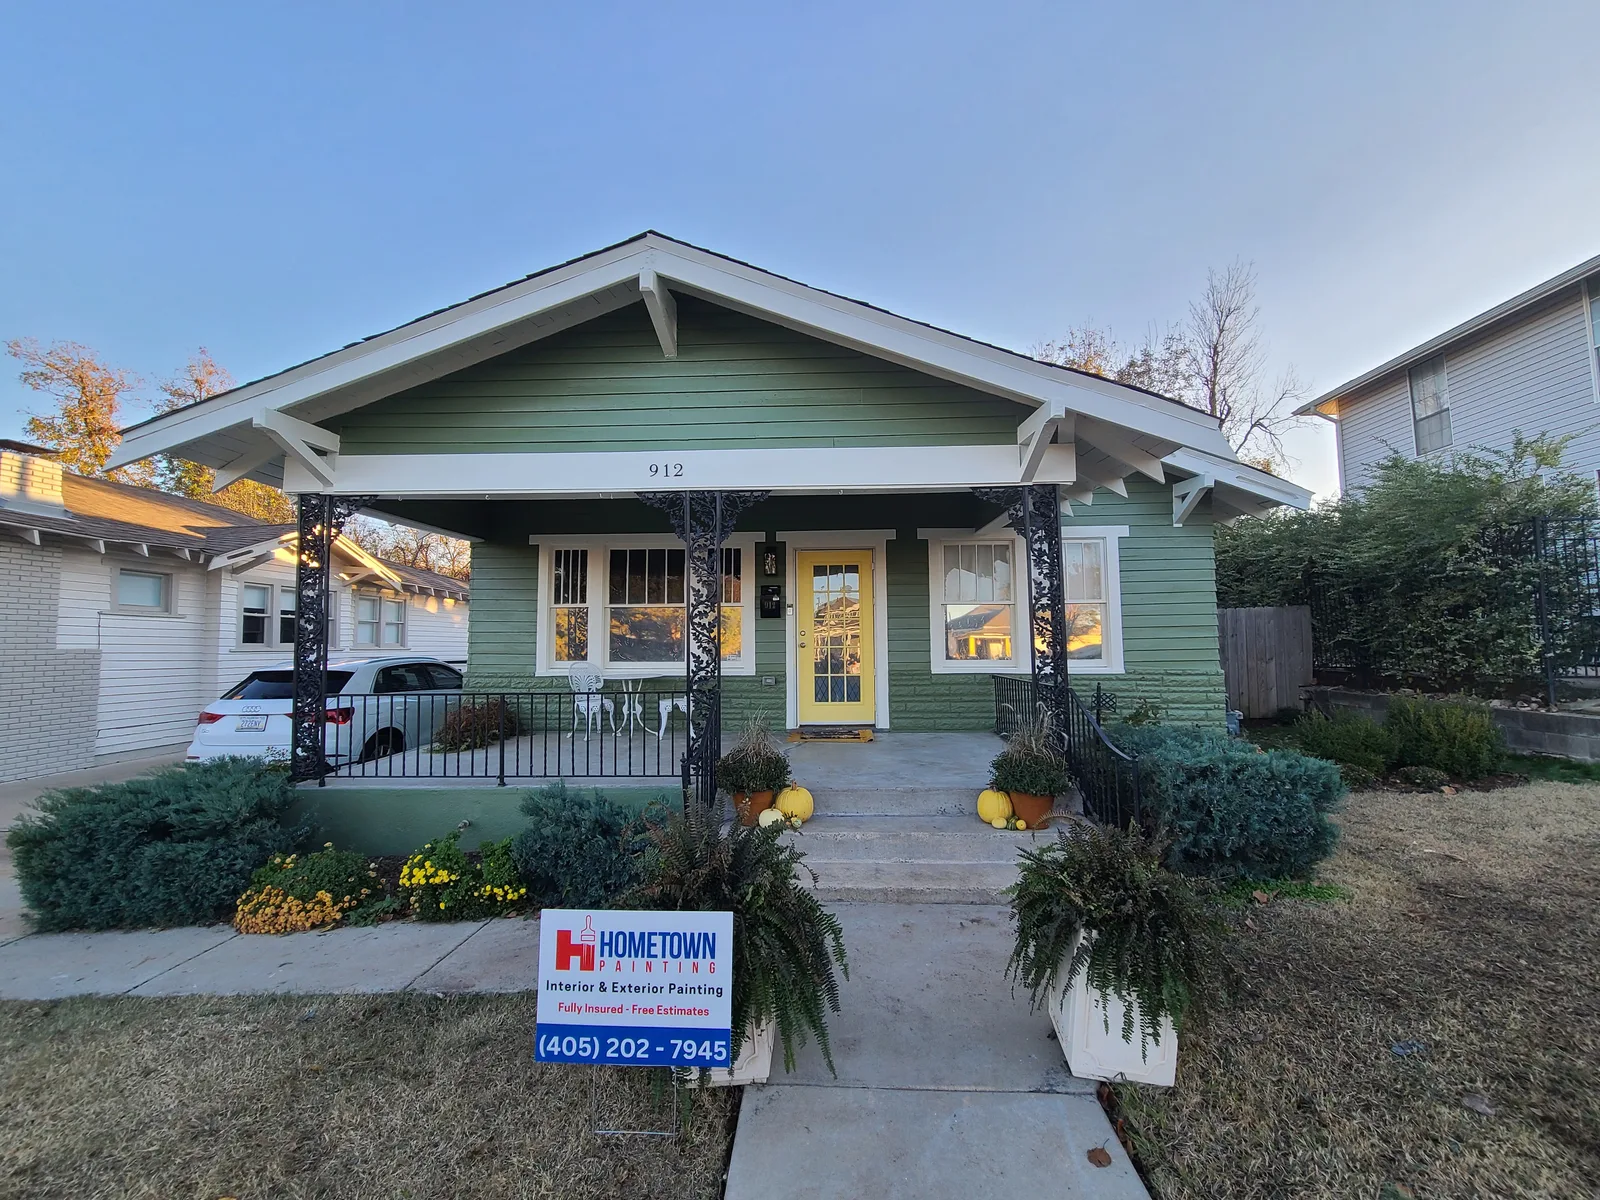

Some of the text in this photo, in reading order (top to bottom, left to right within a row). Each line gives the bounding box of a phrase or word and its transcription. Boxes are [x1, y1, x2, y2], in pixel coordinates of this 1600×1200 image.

[649, 463, 683, 477] 912
[600, 931, 716, 960] HOMETOWN
[599, 960, 716, 974] PAINTING
[546, 980, 723, 998] Interior & Exterior Painting
[558, 1002, 582, 1015] Fully
[584, 1003, 623, 1014] Insured
[631, 1004, 655, 1015] Free
[656, 1004, 710, 1017] Estimates
[538, 1034, 600, 1060] (405)
[606, 1037, 650, 1059] 202
[670, 1039, 727, 1061] 7945
